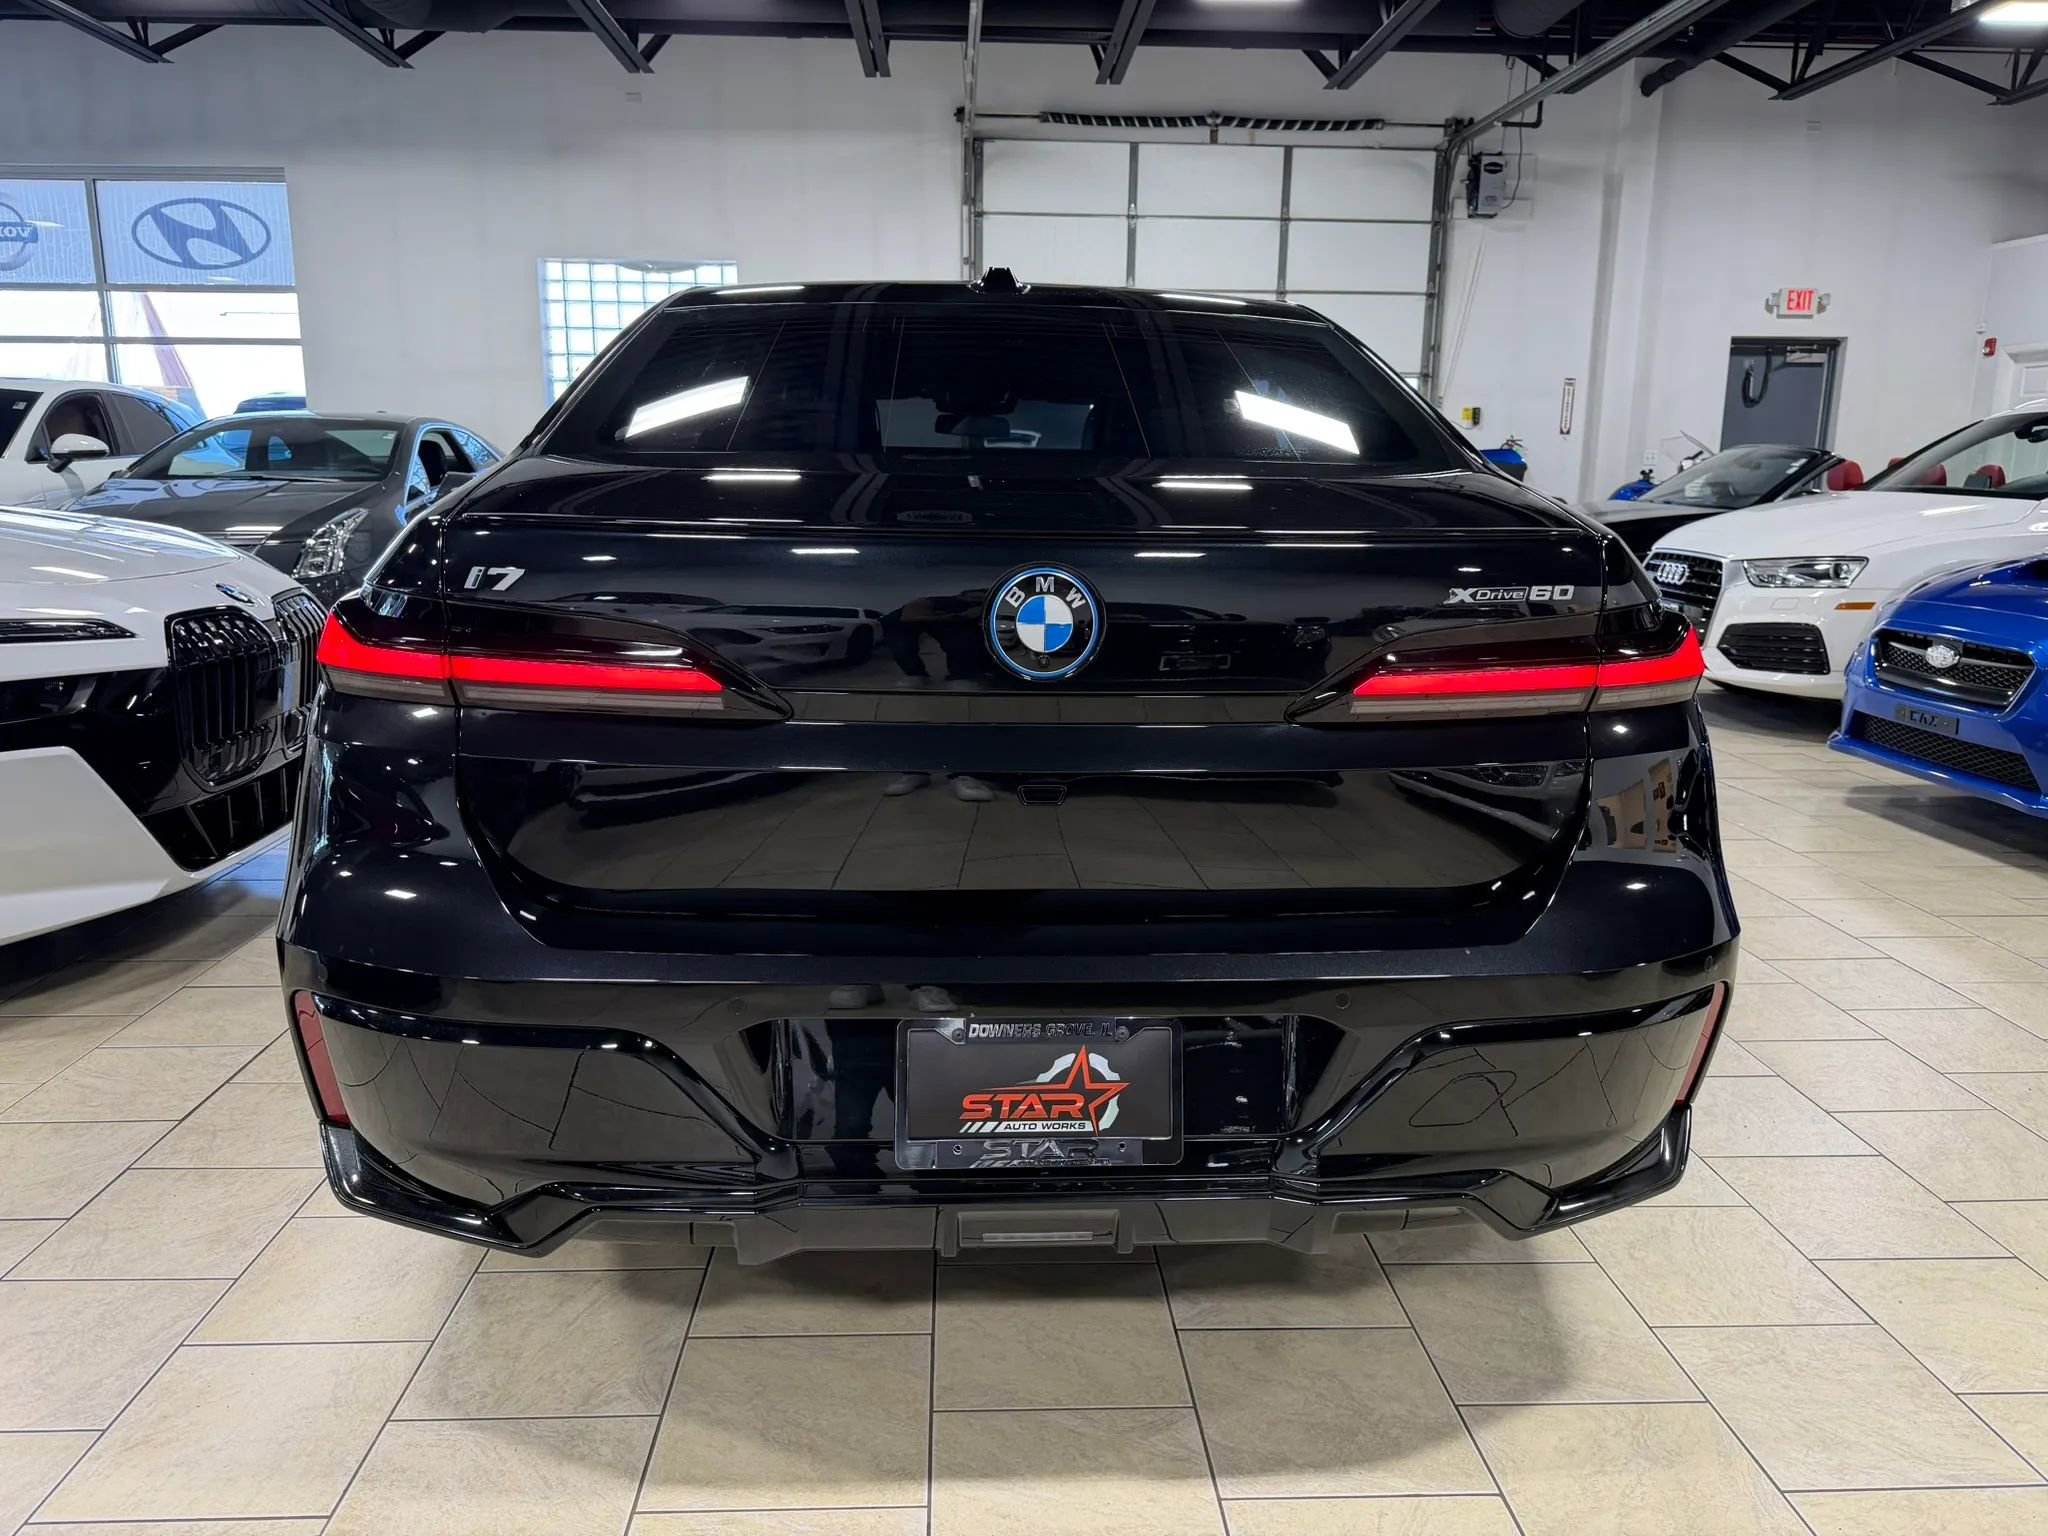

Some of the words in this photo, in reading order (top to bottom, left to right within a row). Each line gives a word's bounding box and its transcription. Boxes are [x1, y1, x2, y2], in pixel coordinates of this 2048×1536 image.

[1787, 290, 1814, 310] EXIT
[464, 566, 526, 591] i7
[1004, 576, 1087, 609] BMW
[968, 1023, 1041, 1038] DOWNERS
[1100, 1023, 1113, 1036] IL
[960, 1094, 1085, 1119] STAR
[1003, 1122, 1038, 1131] AUTO
[1041, 1122, 1086, 1130] WORKS
[980, 1138, 1101, 1160] STAR
